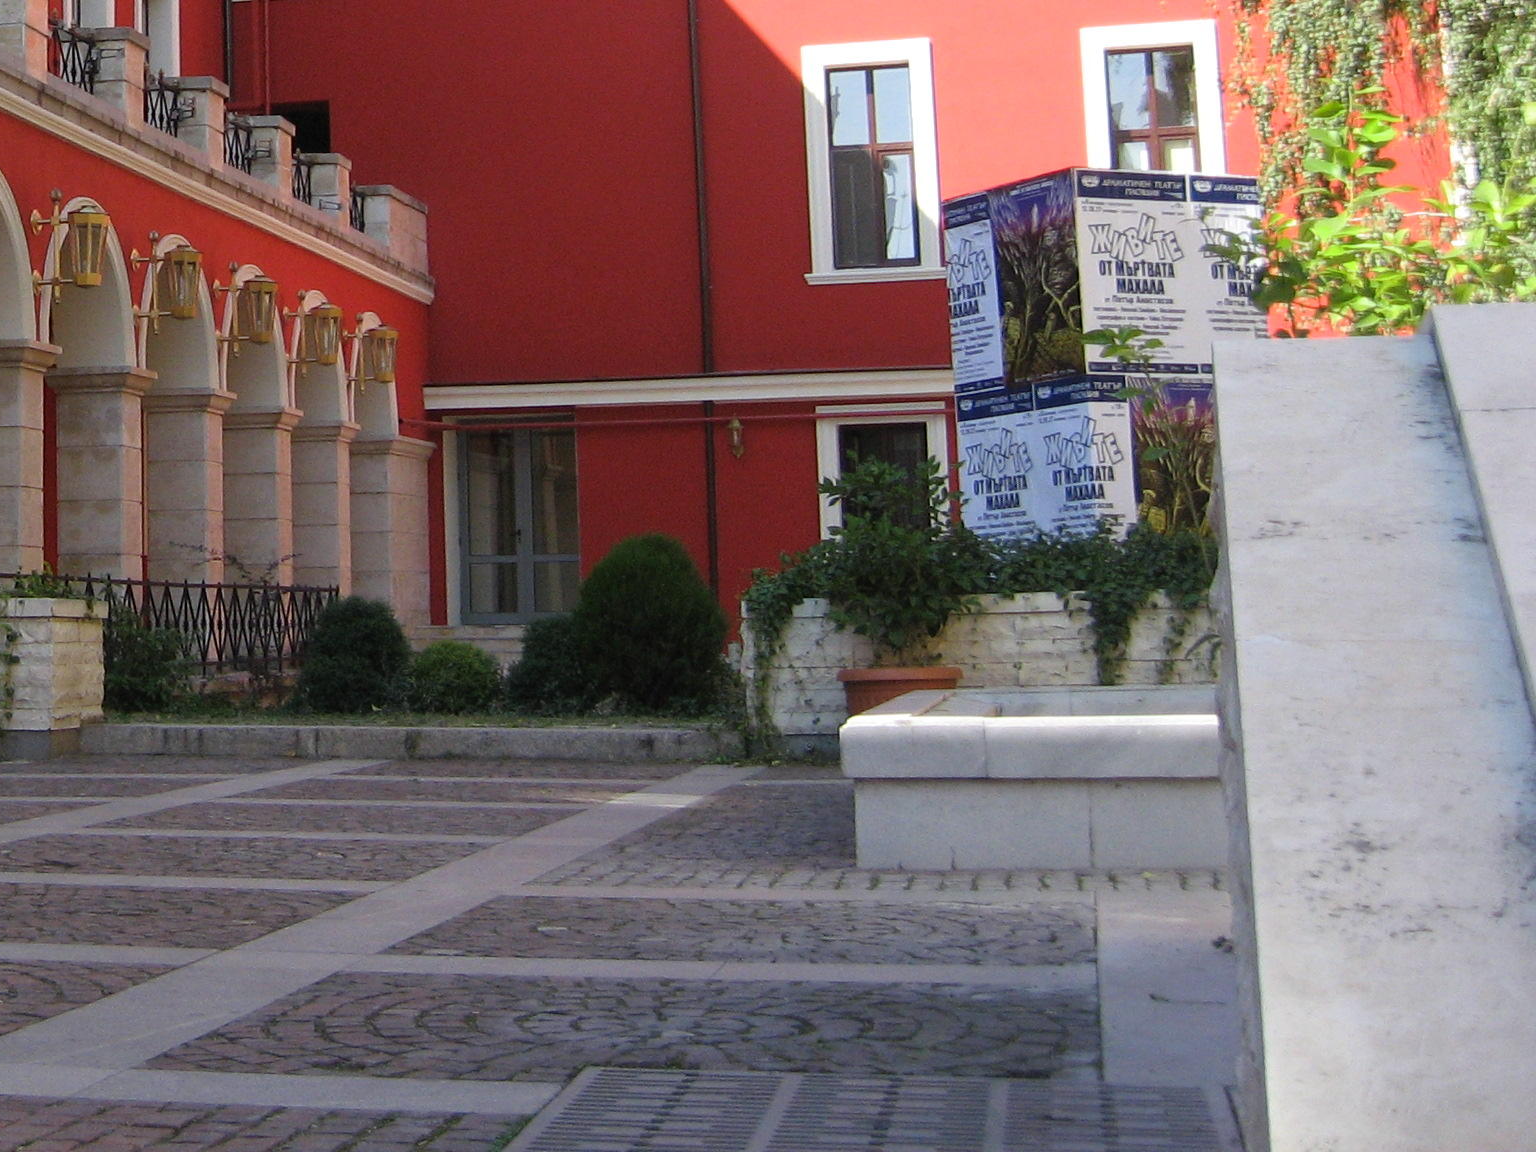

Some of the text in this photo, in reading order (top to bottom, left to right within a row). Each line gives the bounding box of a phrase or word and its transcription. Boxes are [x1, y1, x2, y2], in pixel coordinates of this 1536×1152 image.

[1088, 212, 1185, 263] ЖИВИТЕ
[1099, 259, 1175, 278] ОТ МЪРТВАТА
[1211, 264, 1224, 279] ОТ
[1116, 277, 1165, 295] МАХАЛА
[1228, 281, 1252, 297] МАХ
[1043, 416, 1124, 468] ЖИВИТЕ
[965, 428, 1033, 478] ЖИВИТЕ
[1052, 470, 1062, 486] ОТ
[973, 480, 984, 495] ОТ
[1065, 483, 1105, 501] МАХАЛА
[986, 493, 1021, 510] МАХАЛА
